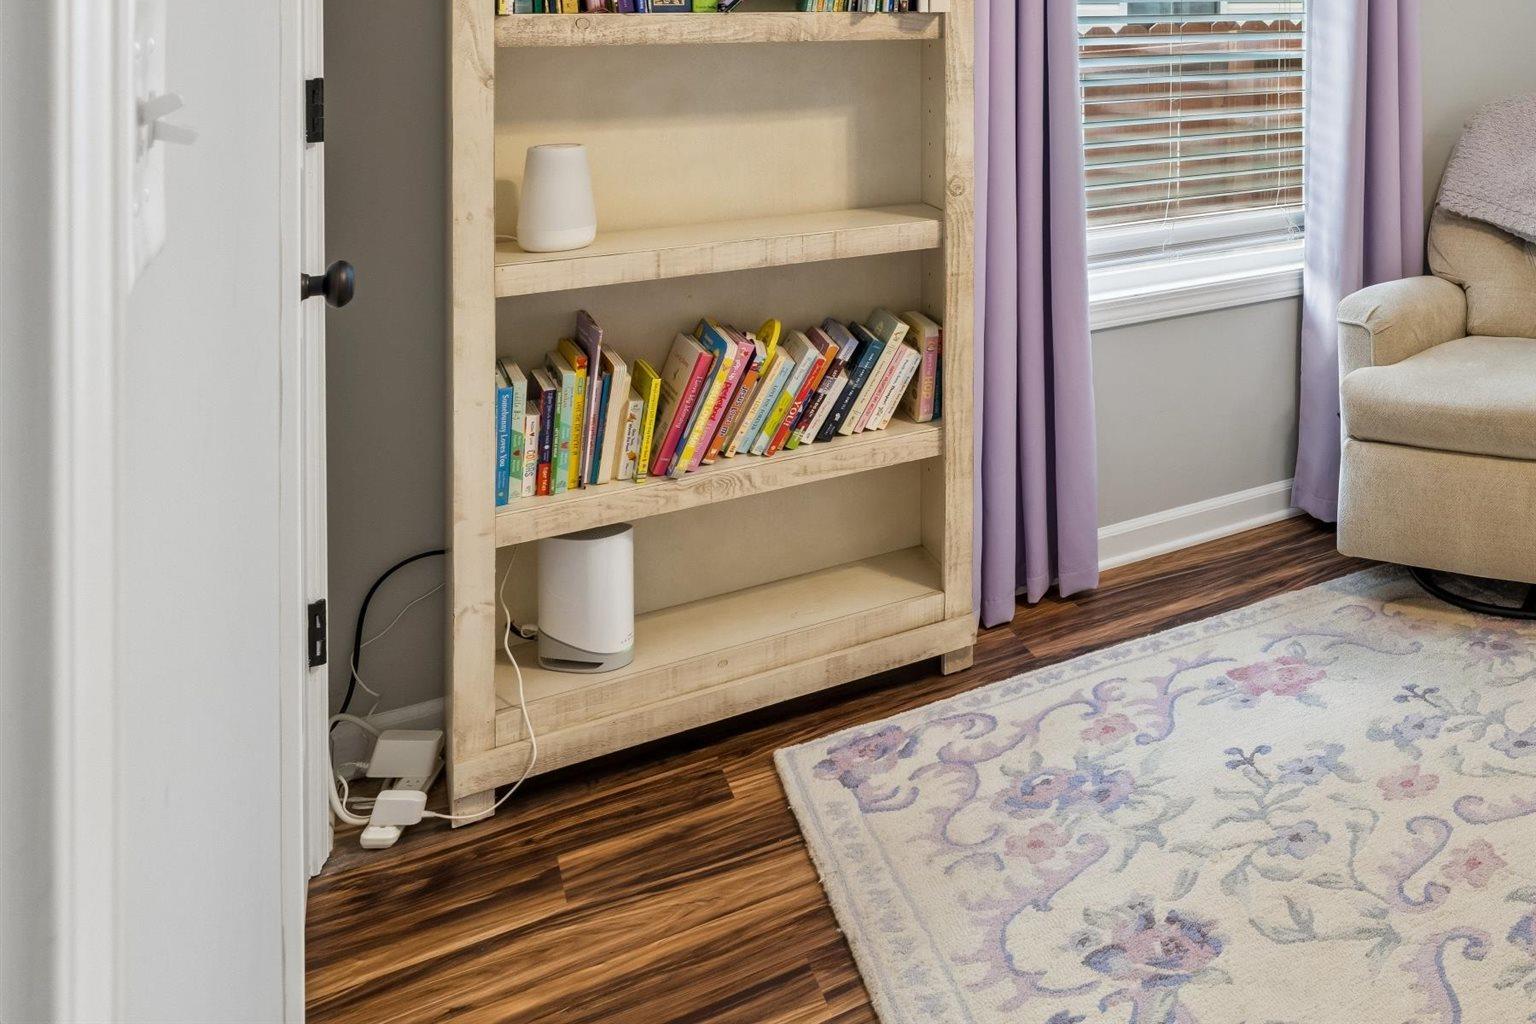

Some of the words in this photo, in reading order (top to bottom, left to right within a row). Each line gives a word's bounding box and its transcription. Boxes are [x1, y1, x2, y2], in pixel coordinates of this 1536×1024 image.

[499, 394, 508, 432] Somebunny
[782, 399, 801, 427] YOU!
[499, 434, 507, 453] Loves
